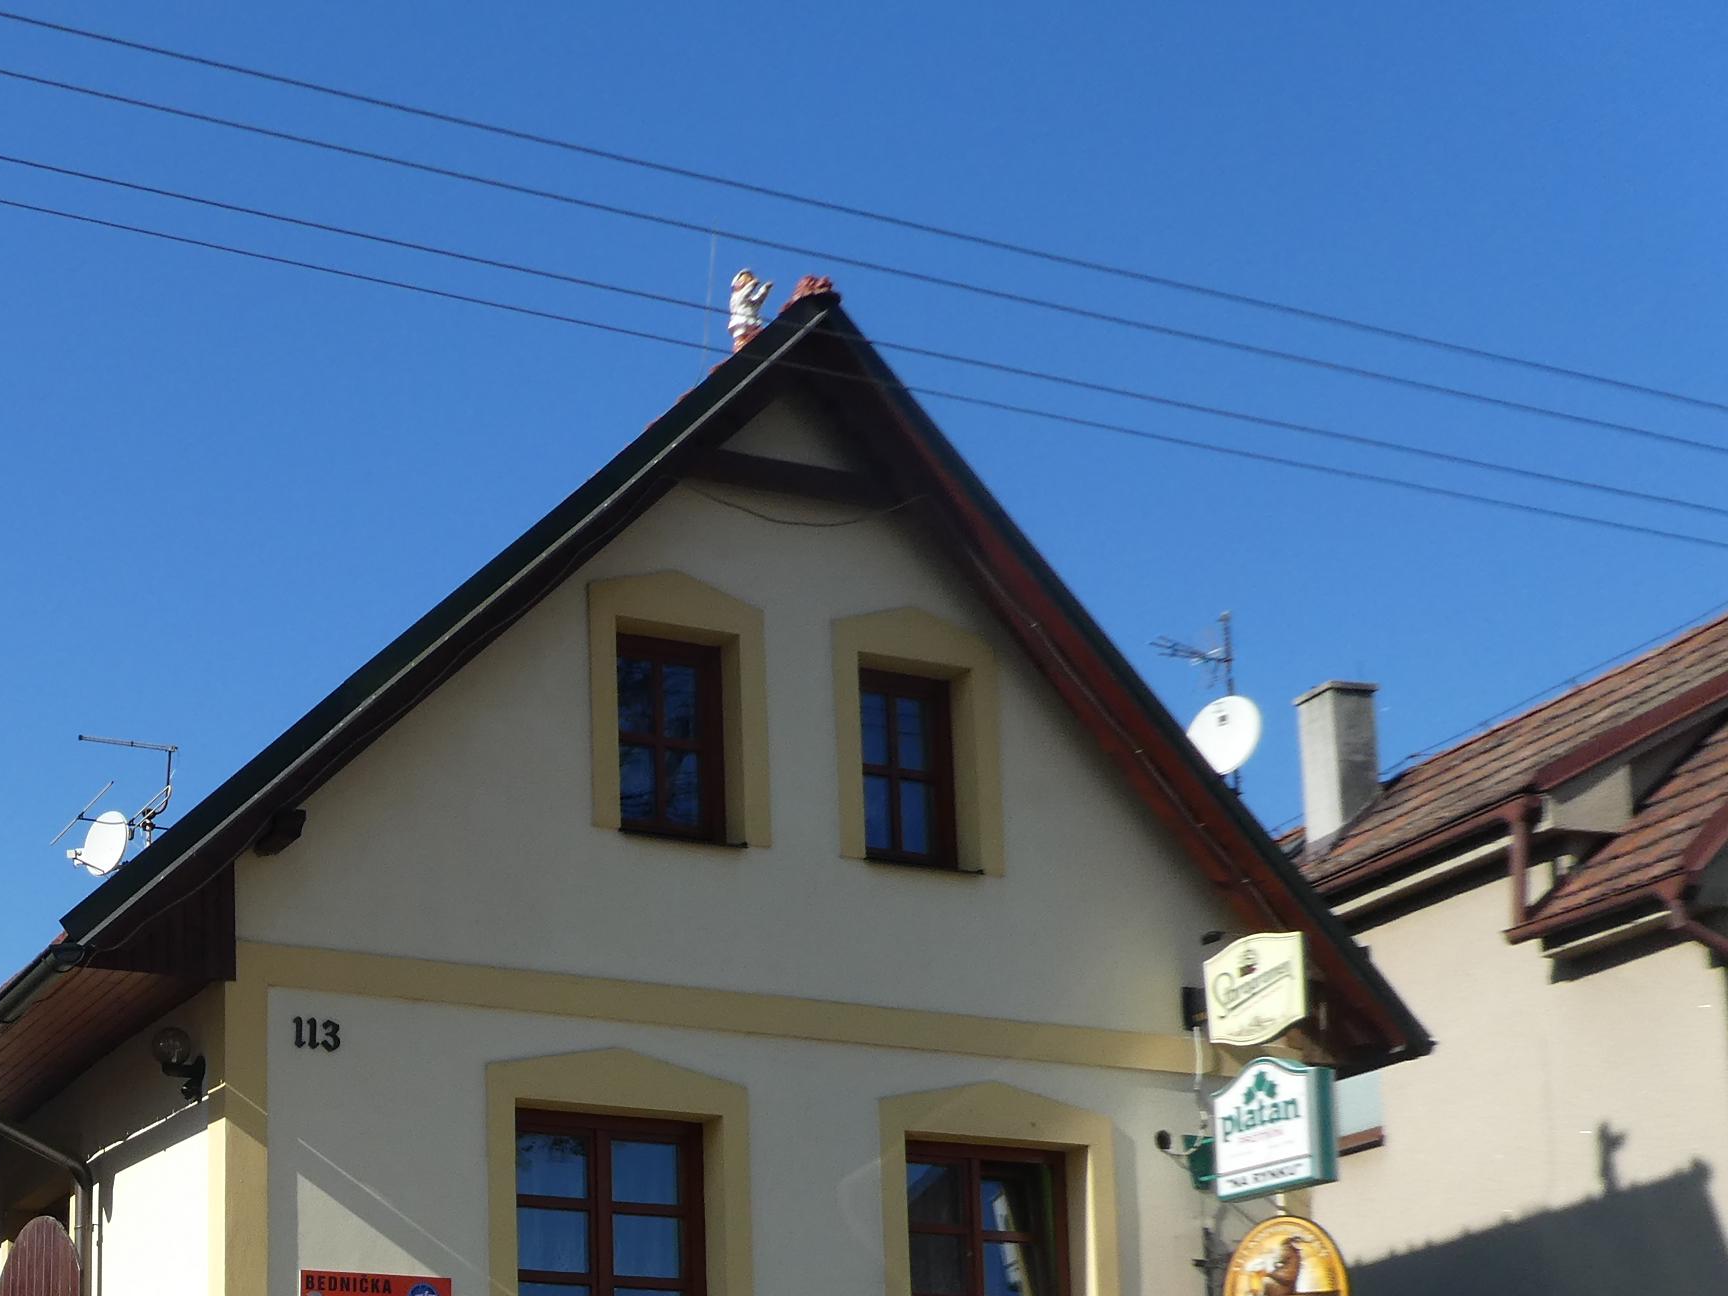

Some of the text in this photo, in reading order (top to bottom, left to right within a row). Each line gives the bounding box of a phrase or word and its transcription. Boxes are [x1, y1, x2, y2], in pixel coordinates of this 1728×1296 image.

[292, 1016, 341, 1053] 113
[1222, 1098, 1301, 1142] platan
[305, 1274, 392, 1294] BEDNIČKA
